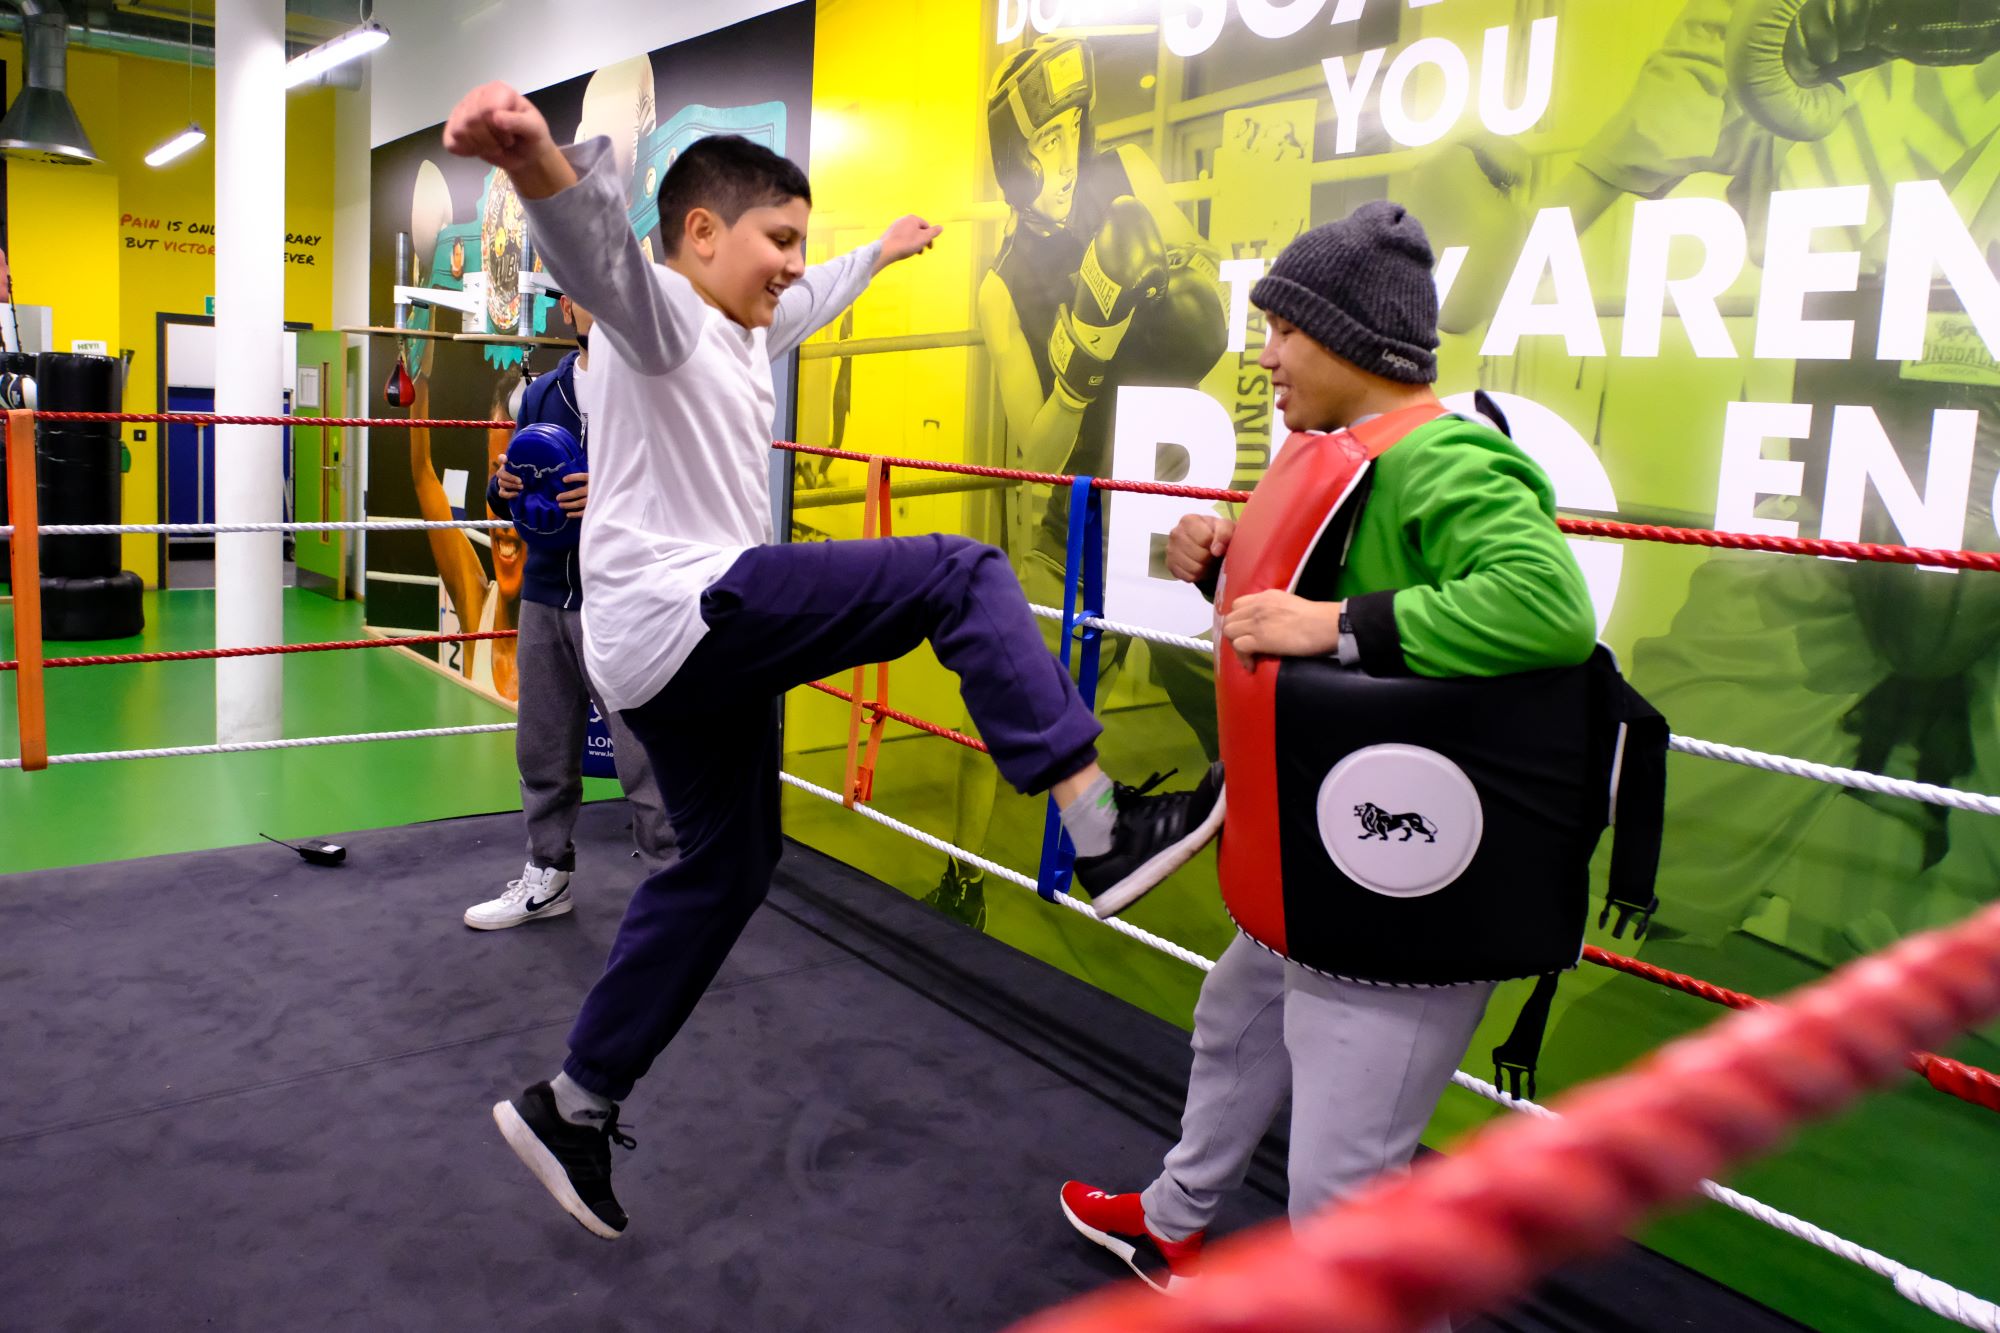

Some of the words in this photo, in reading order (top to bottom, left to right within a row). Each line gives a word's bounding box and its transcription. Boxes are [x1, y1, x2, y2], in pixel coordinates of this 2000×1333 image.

[1321, 16, 1557, 153] YOU
[120, 213, 160, 229] PAIN
[167, 221, 183, 231] IS
[125, 237, 159, 249] BUT
[1713, 401, 2000, 574] EN
